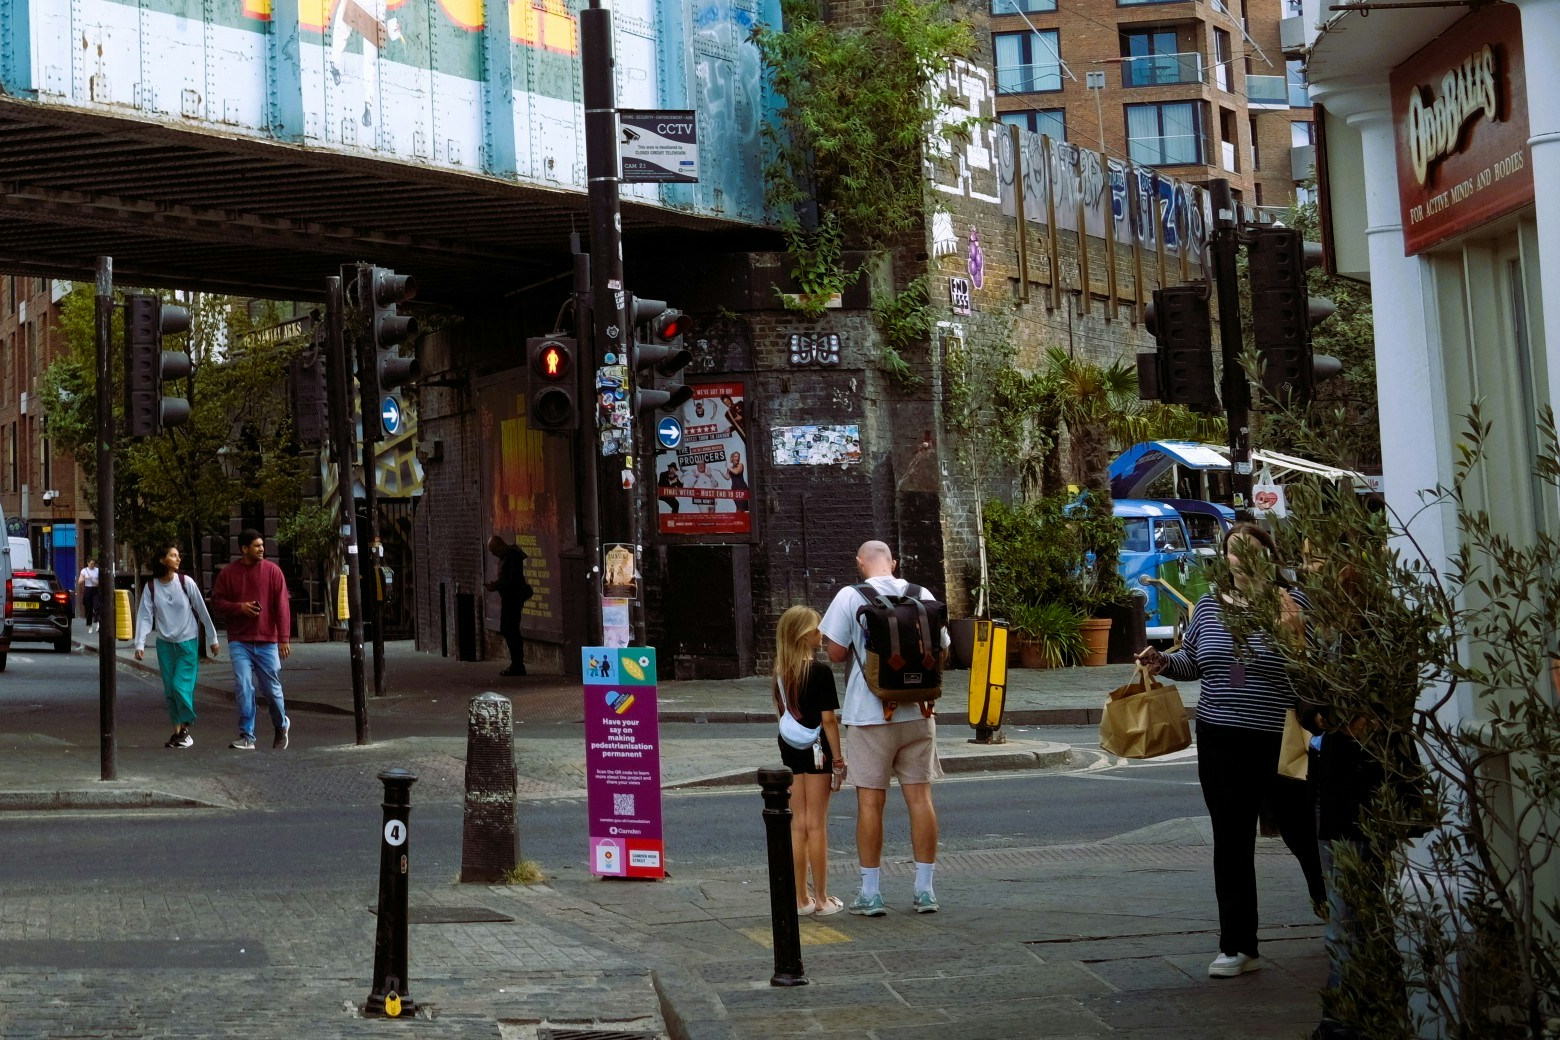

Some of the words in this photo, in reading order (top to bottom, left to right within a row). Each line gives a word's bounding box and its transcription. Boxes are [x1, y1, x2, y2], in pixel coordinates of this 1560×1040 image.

[657, 123, 693, 135] CCTV
[1410, 207, 1424, 225] FOR
[1426, 190, 1450, 217] ACTIVE
[1451, 177, 1474, 203] MINDS
[1476, 168, 1492, 192] AND
[1494, 150, 1524, 182] BODIES
[679, 451, 725, 465] PRODUCERS
[663, 488, 678, 496] FINAL
[679, 488, 695, 497] WEEKS
[701, 489, 715, 497] MUST
[716, 490, 727, 498] END
[607, 734, 635, 743] making
[590, 742, 653, 750] pedestrianisation
[390, 824, 400, 841] 4
